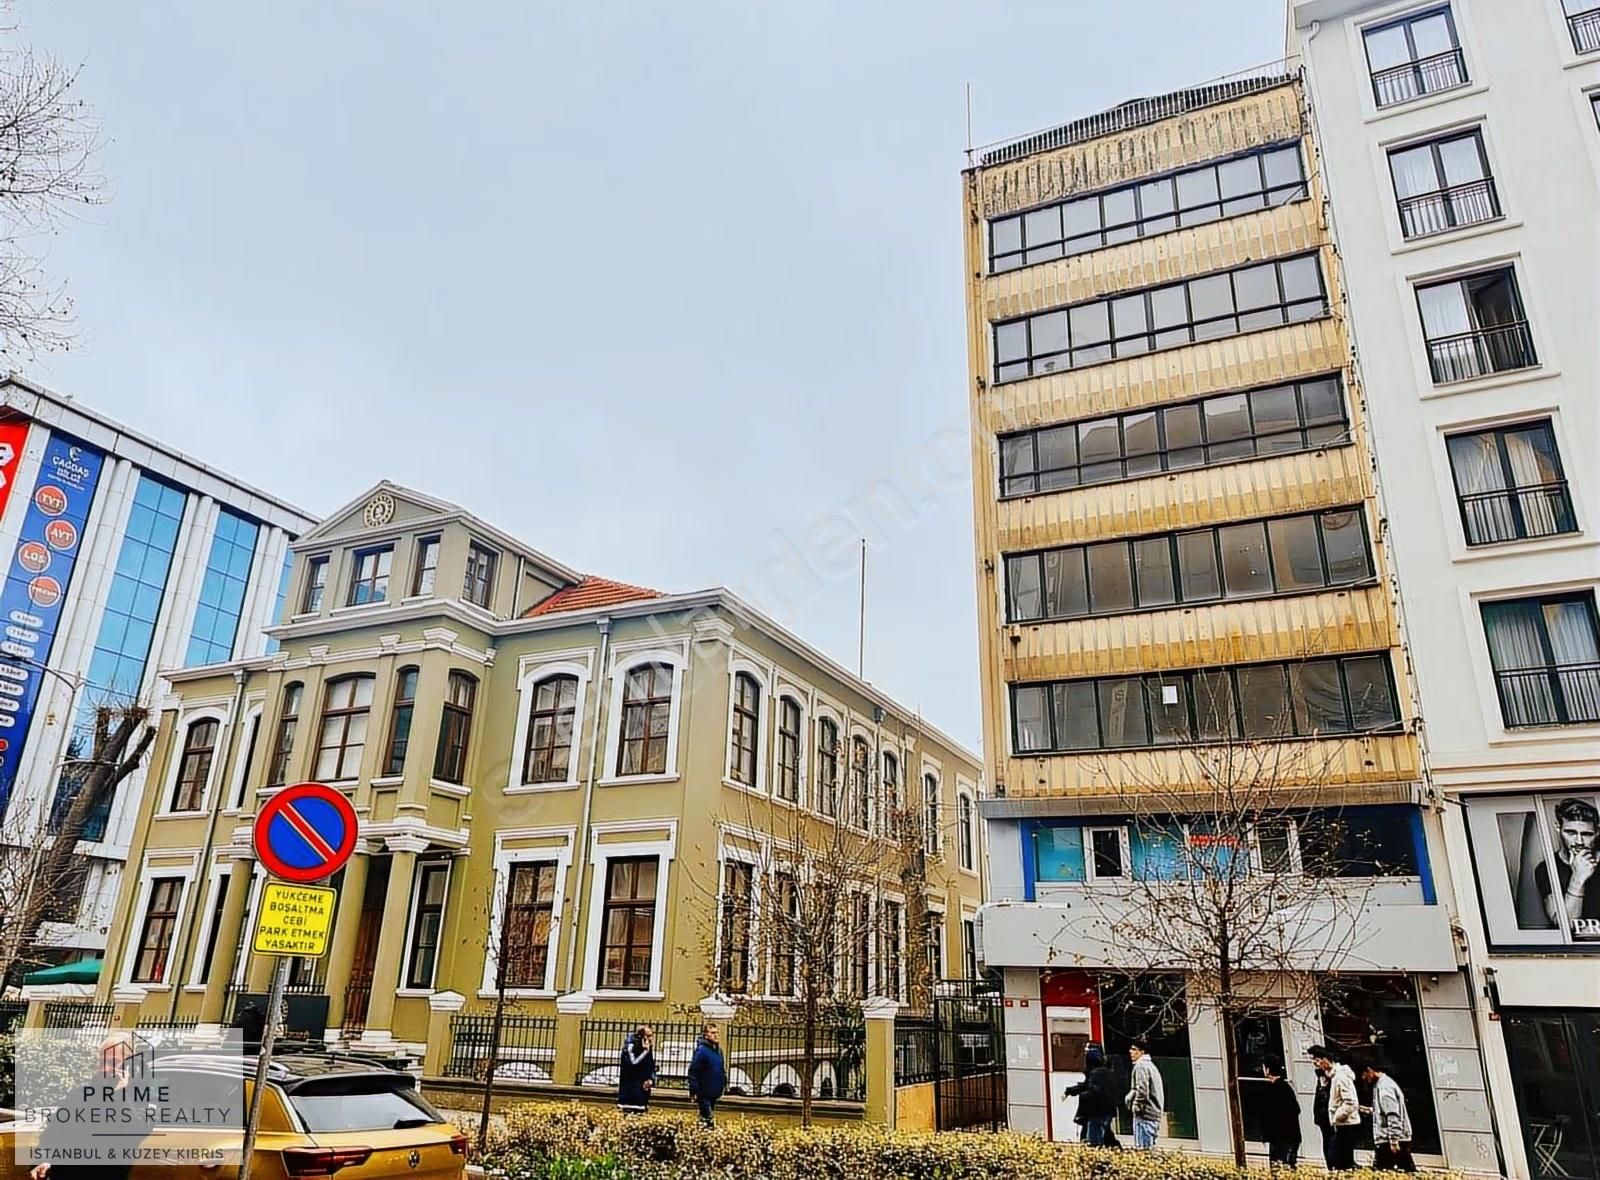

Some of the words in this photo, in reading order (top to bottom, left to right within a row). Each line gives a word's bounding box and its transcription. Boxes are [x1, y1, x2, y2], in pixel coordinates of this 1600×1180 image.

[41, 494, 62, 508] TYT
[50, 527, 73, 541] AYT
[260, 926, 288, 936] PARK
[291, 928, 324, 939] ETMEK
[265, 939, 315, 951] YASAKTIR
